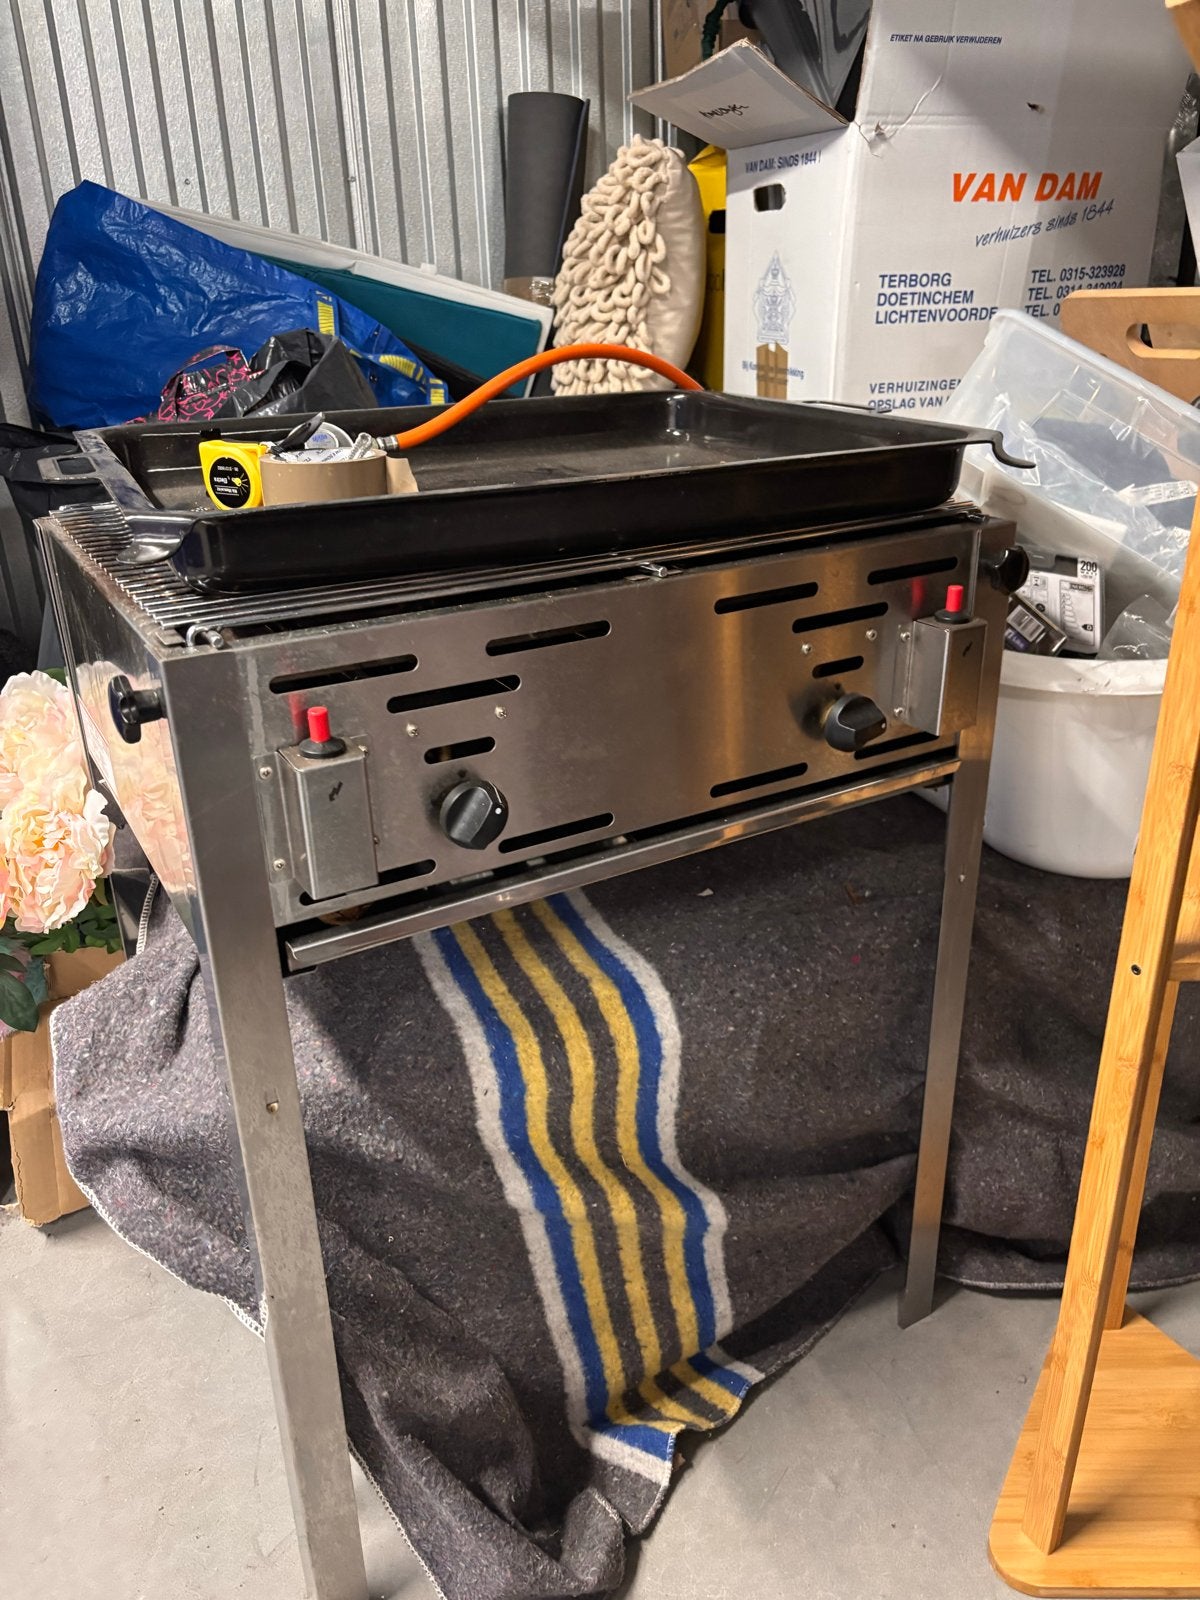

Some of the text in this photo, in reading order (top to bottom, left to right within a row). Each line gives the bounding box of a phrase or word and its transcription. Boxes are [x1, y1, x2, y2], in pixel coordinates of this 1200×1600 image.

[890, 34, 1002, 45] ETIKET NA GEBRUIK VERWIJDEREN
[745, 161, 758, 174] VAN
[777, 153, 799, 169] SINDS
[801, 150, 817, 166] 1844
[952, 171, 1103, 203] VAN DAM
[975, 199, 1115, 248] verhuizers sinds 1844
[879, 272, 952, 289] TERBORG
[1031, 264, 1126, 284] TEL. 0315-323928
[877, 290, 974, 307] DOETINCHEM
[1028, 287, 1053, 301] TEL.
[1024, 304, 1049, 318] TEL.
[868, 397, 916, 410] OPSLAG
[919, 396, 943, 408] VAN
[1080, 560, 1098, 572] 200
